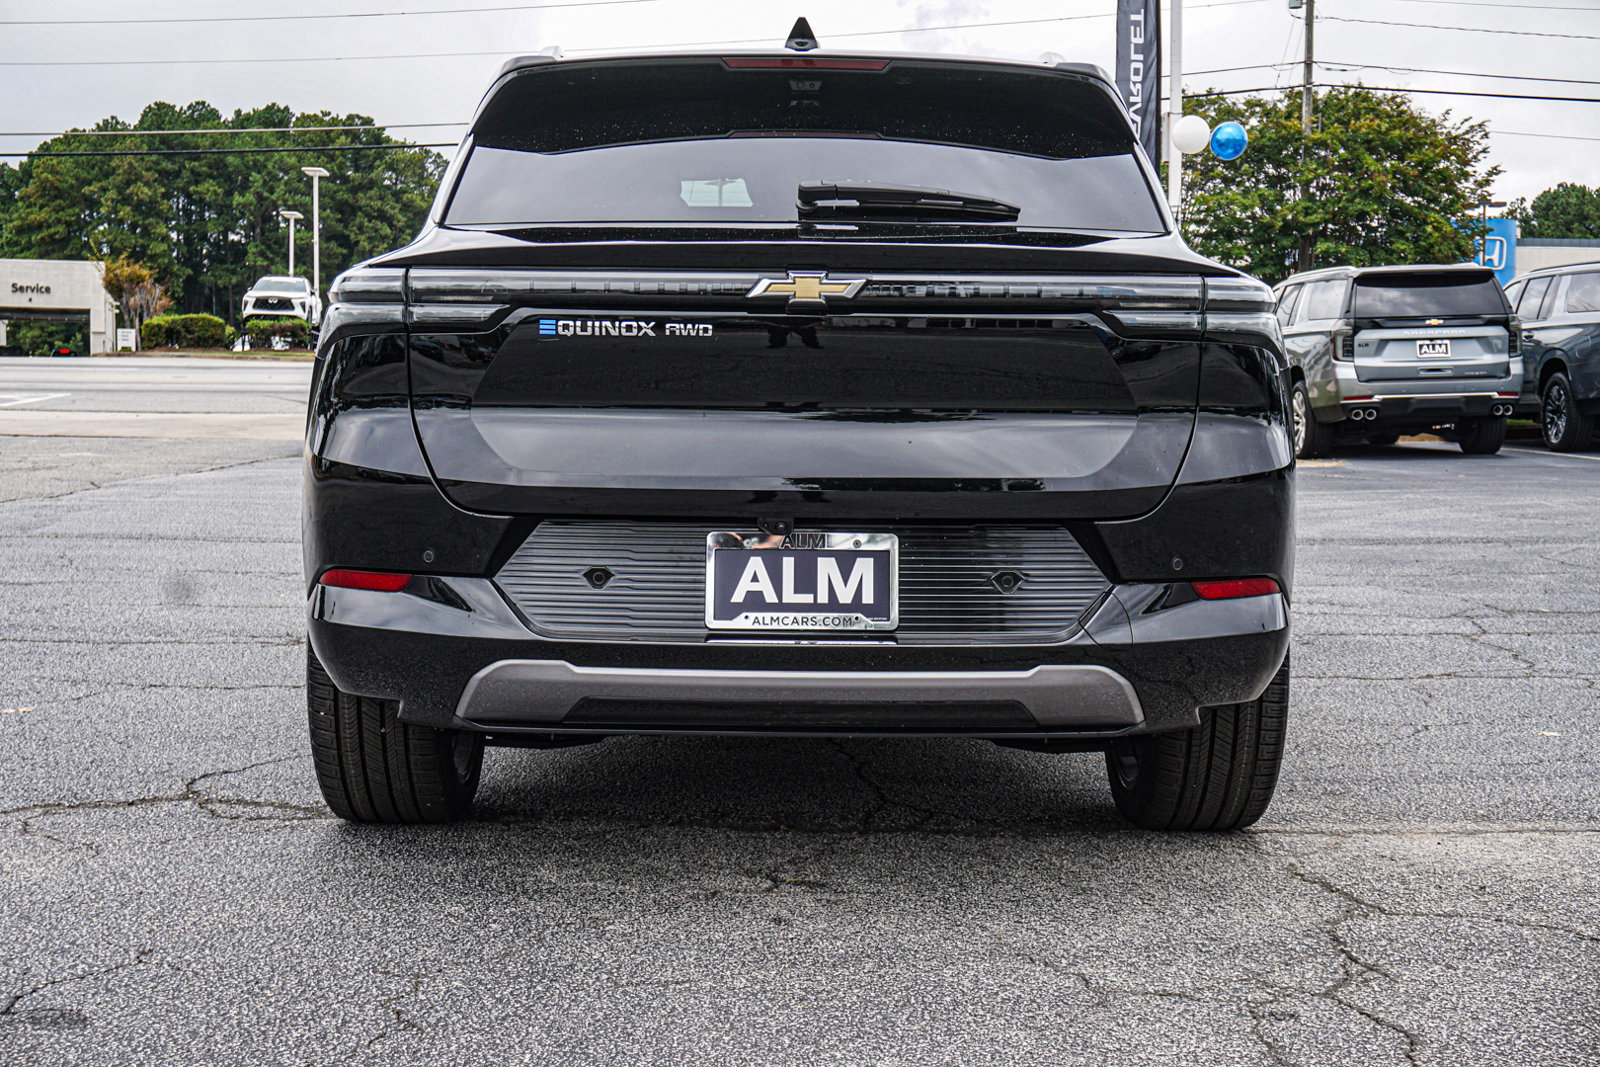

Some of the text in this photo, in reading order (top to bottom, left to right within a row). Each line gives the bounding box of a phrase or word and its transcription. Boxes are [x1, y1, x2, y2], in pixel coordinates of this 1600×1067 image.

[11, 282, 51, 294] Service
[539, 319, 713, 337] EQUINOX AWD
[1420, 344, 1447, 354] ALM
[779, 533, 828, 549] ALM
[730, 556, 874, 605] ALM
[752, 616, 852, 626] ALMCARS.COM
